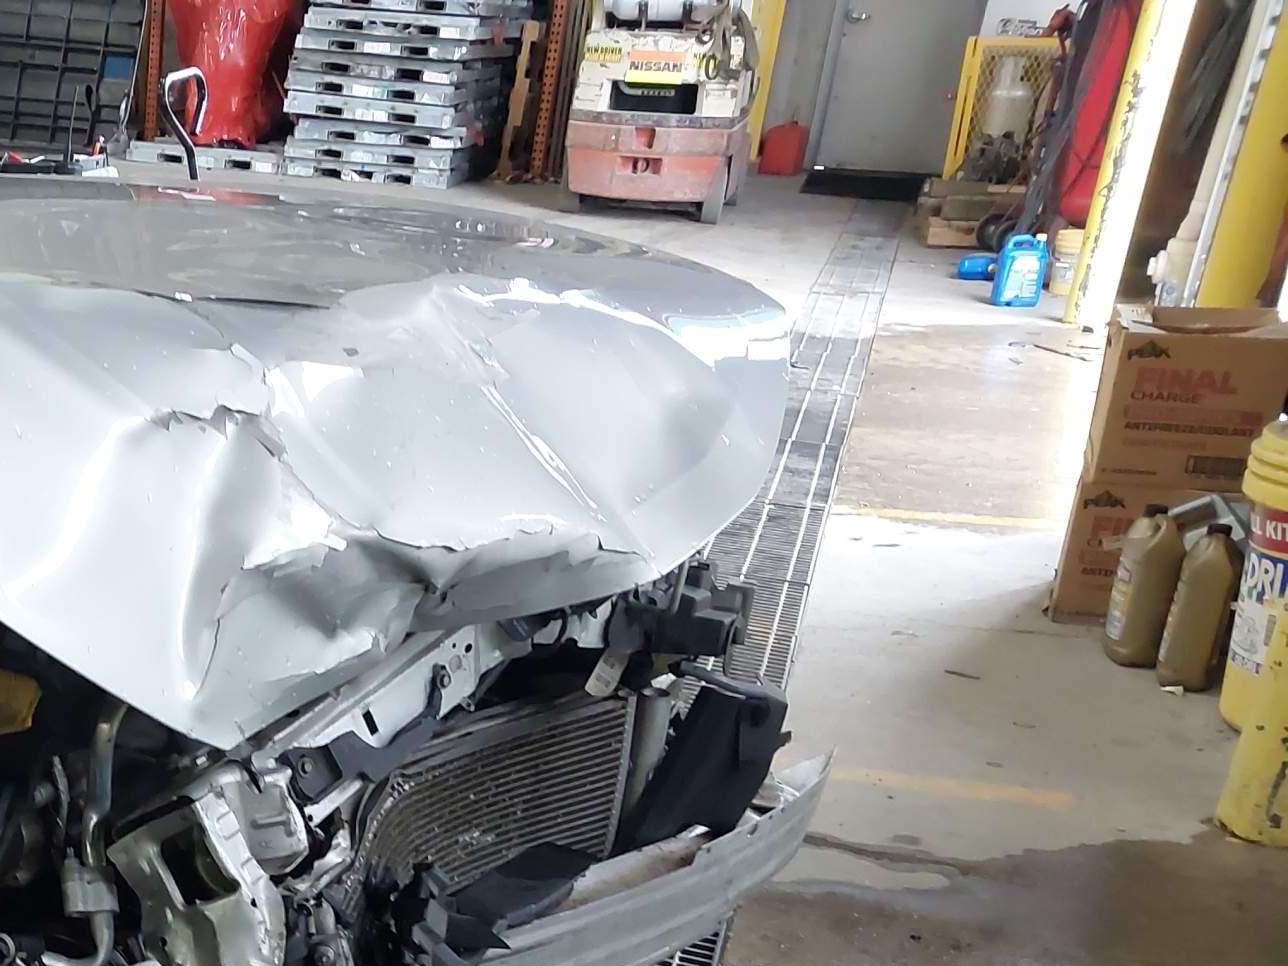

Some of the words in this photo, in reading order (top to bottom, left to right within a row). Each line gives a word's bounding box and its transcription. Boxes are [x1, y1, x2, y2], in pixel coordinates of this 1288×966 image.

[629, 61, 683, 72] NISSAN
[1134, 367, 1238, 394] FINAL
[1130, 391, 1200, 404] CHARGE
